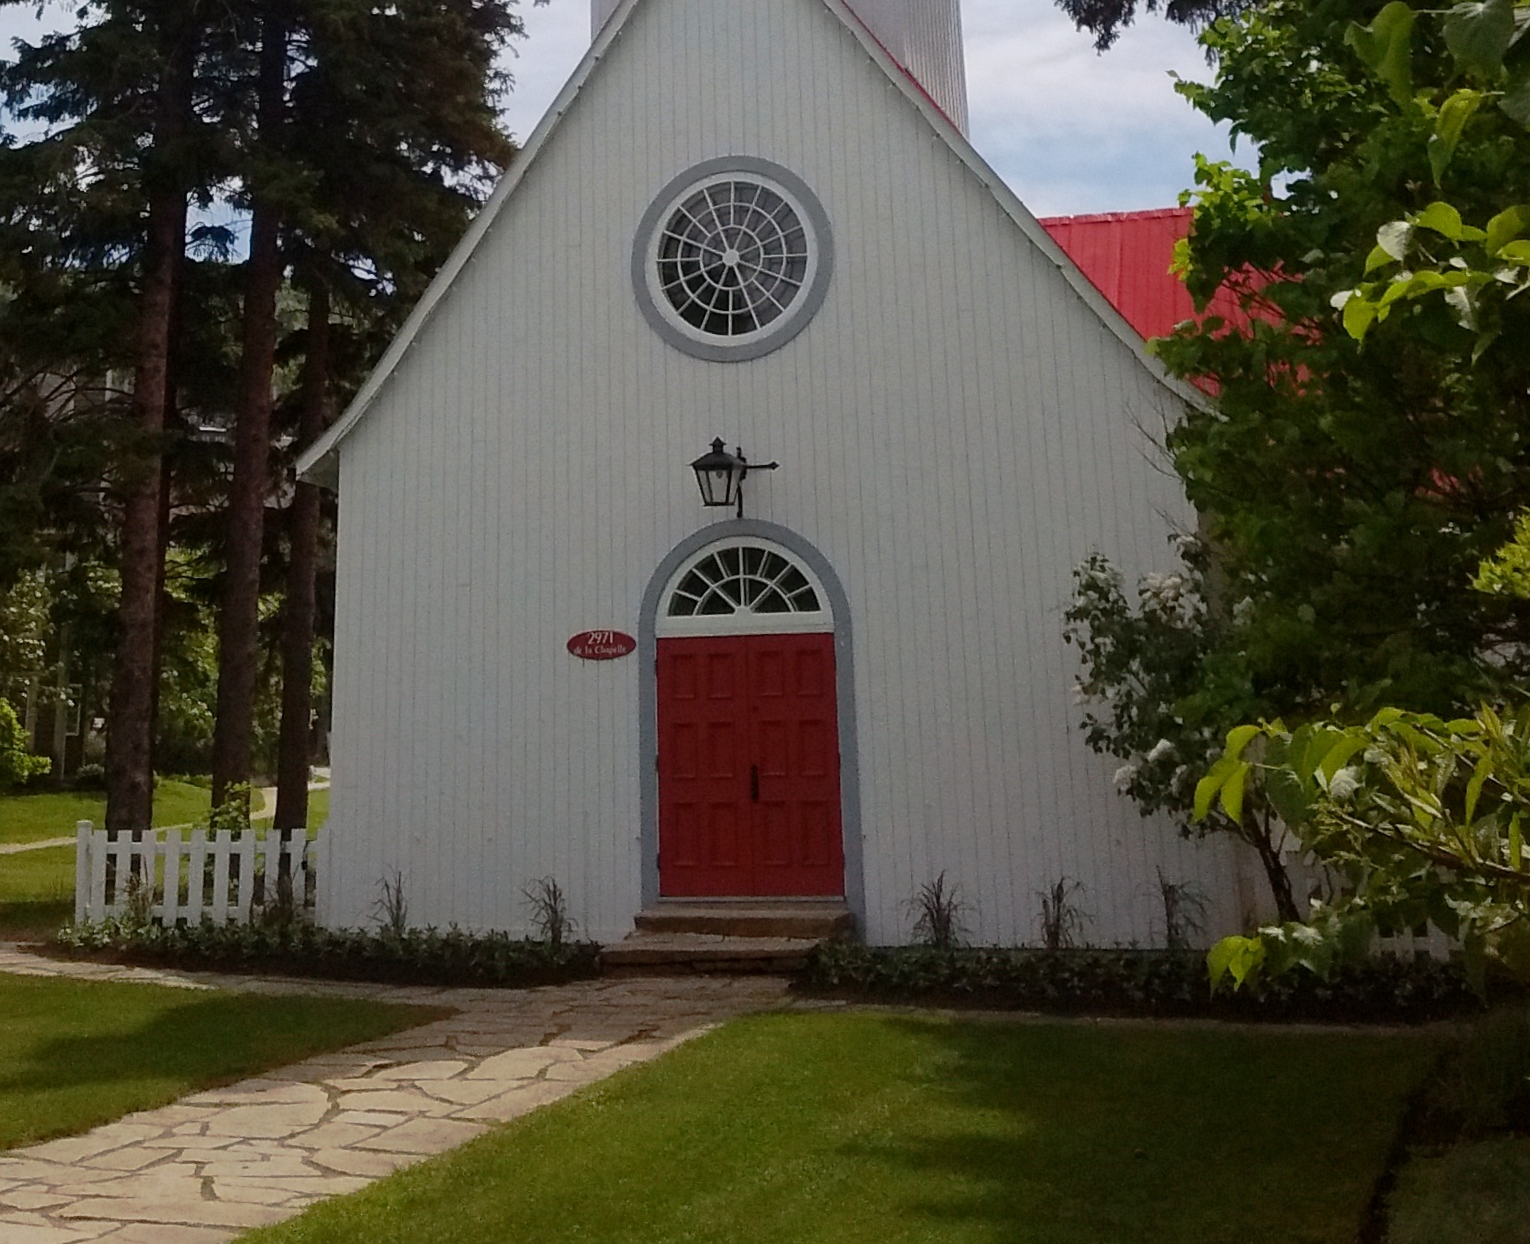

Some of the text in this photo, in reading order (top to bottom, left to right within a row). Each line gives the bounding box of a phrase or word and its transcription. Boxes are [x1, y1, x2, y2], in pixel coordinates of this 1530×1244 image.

[587, 631, 614, 644] 2971
[573, 644, 626, 655] de la Chapelle
